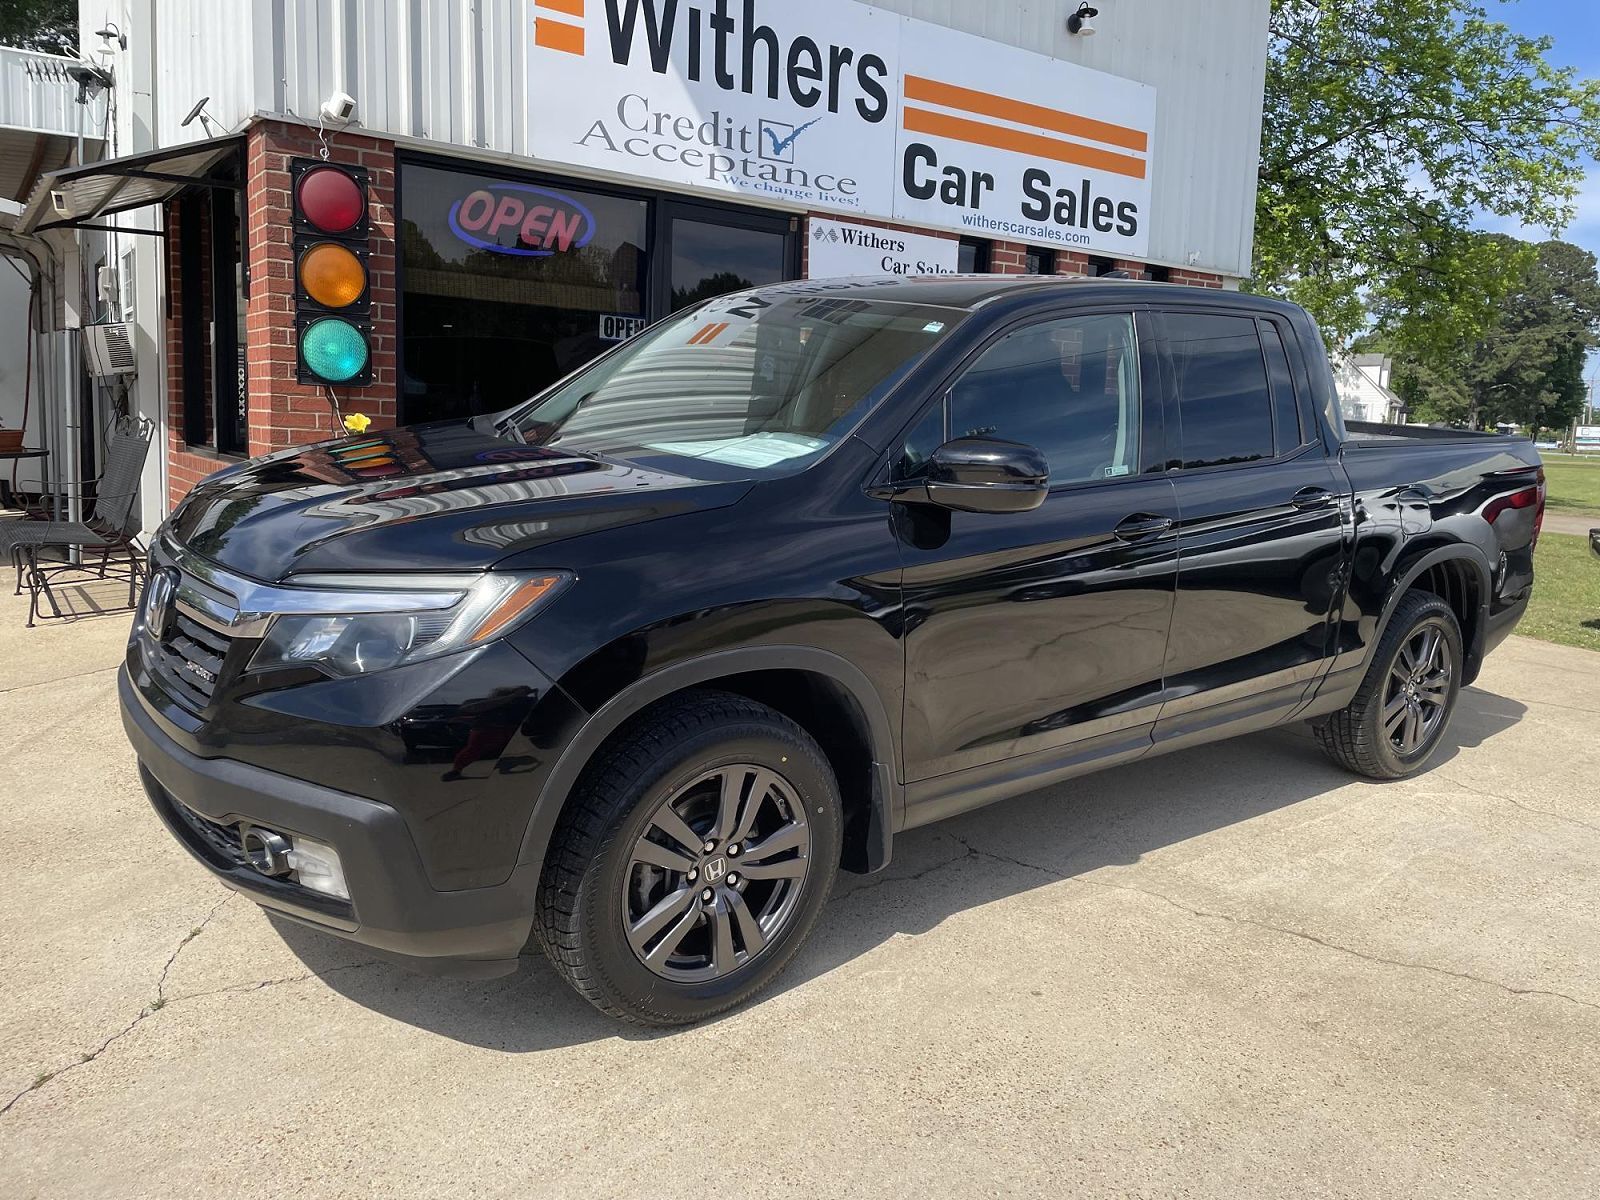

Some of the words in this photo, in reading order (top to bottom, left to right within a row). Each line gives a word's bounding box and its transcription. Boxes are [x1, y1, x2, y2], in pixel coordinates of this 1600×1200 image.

[604, 0, 889, 124] Withers
[617, 93, 753, 154] Credit
[573, 119, 857, 195] Acceptance
[722, 174, 749, 187] We
[754, 181, 813, 200] change
[819, 191, 860, 207] lives!
[903, 142, 994, 209] Car
[1021, 168, 1138, 237] Sales
[459, 189, 582, 252] OPEN
[841, 228, 905, 252] Withers
[962, 213, 1091, 245] witherscarsales.com
[881, 256, 910, 275] Car
